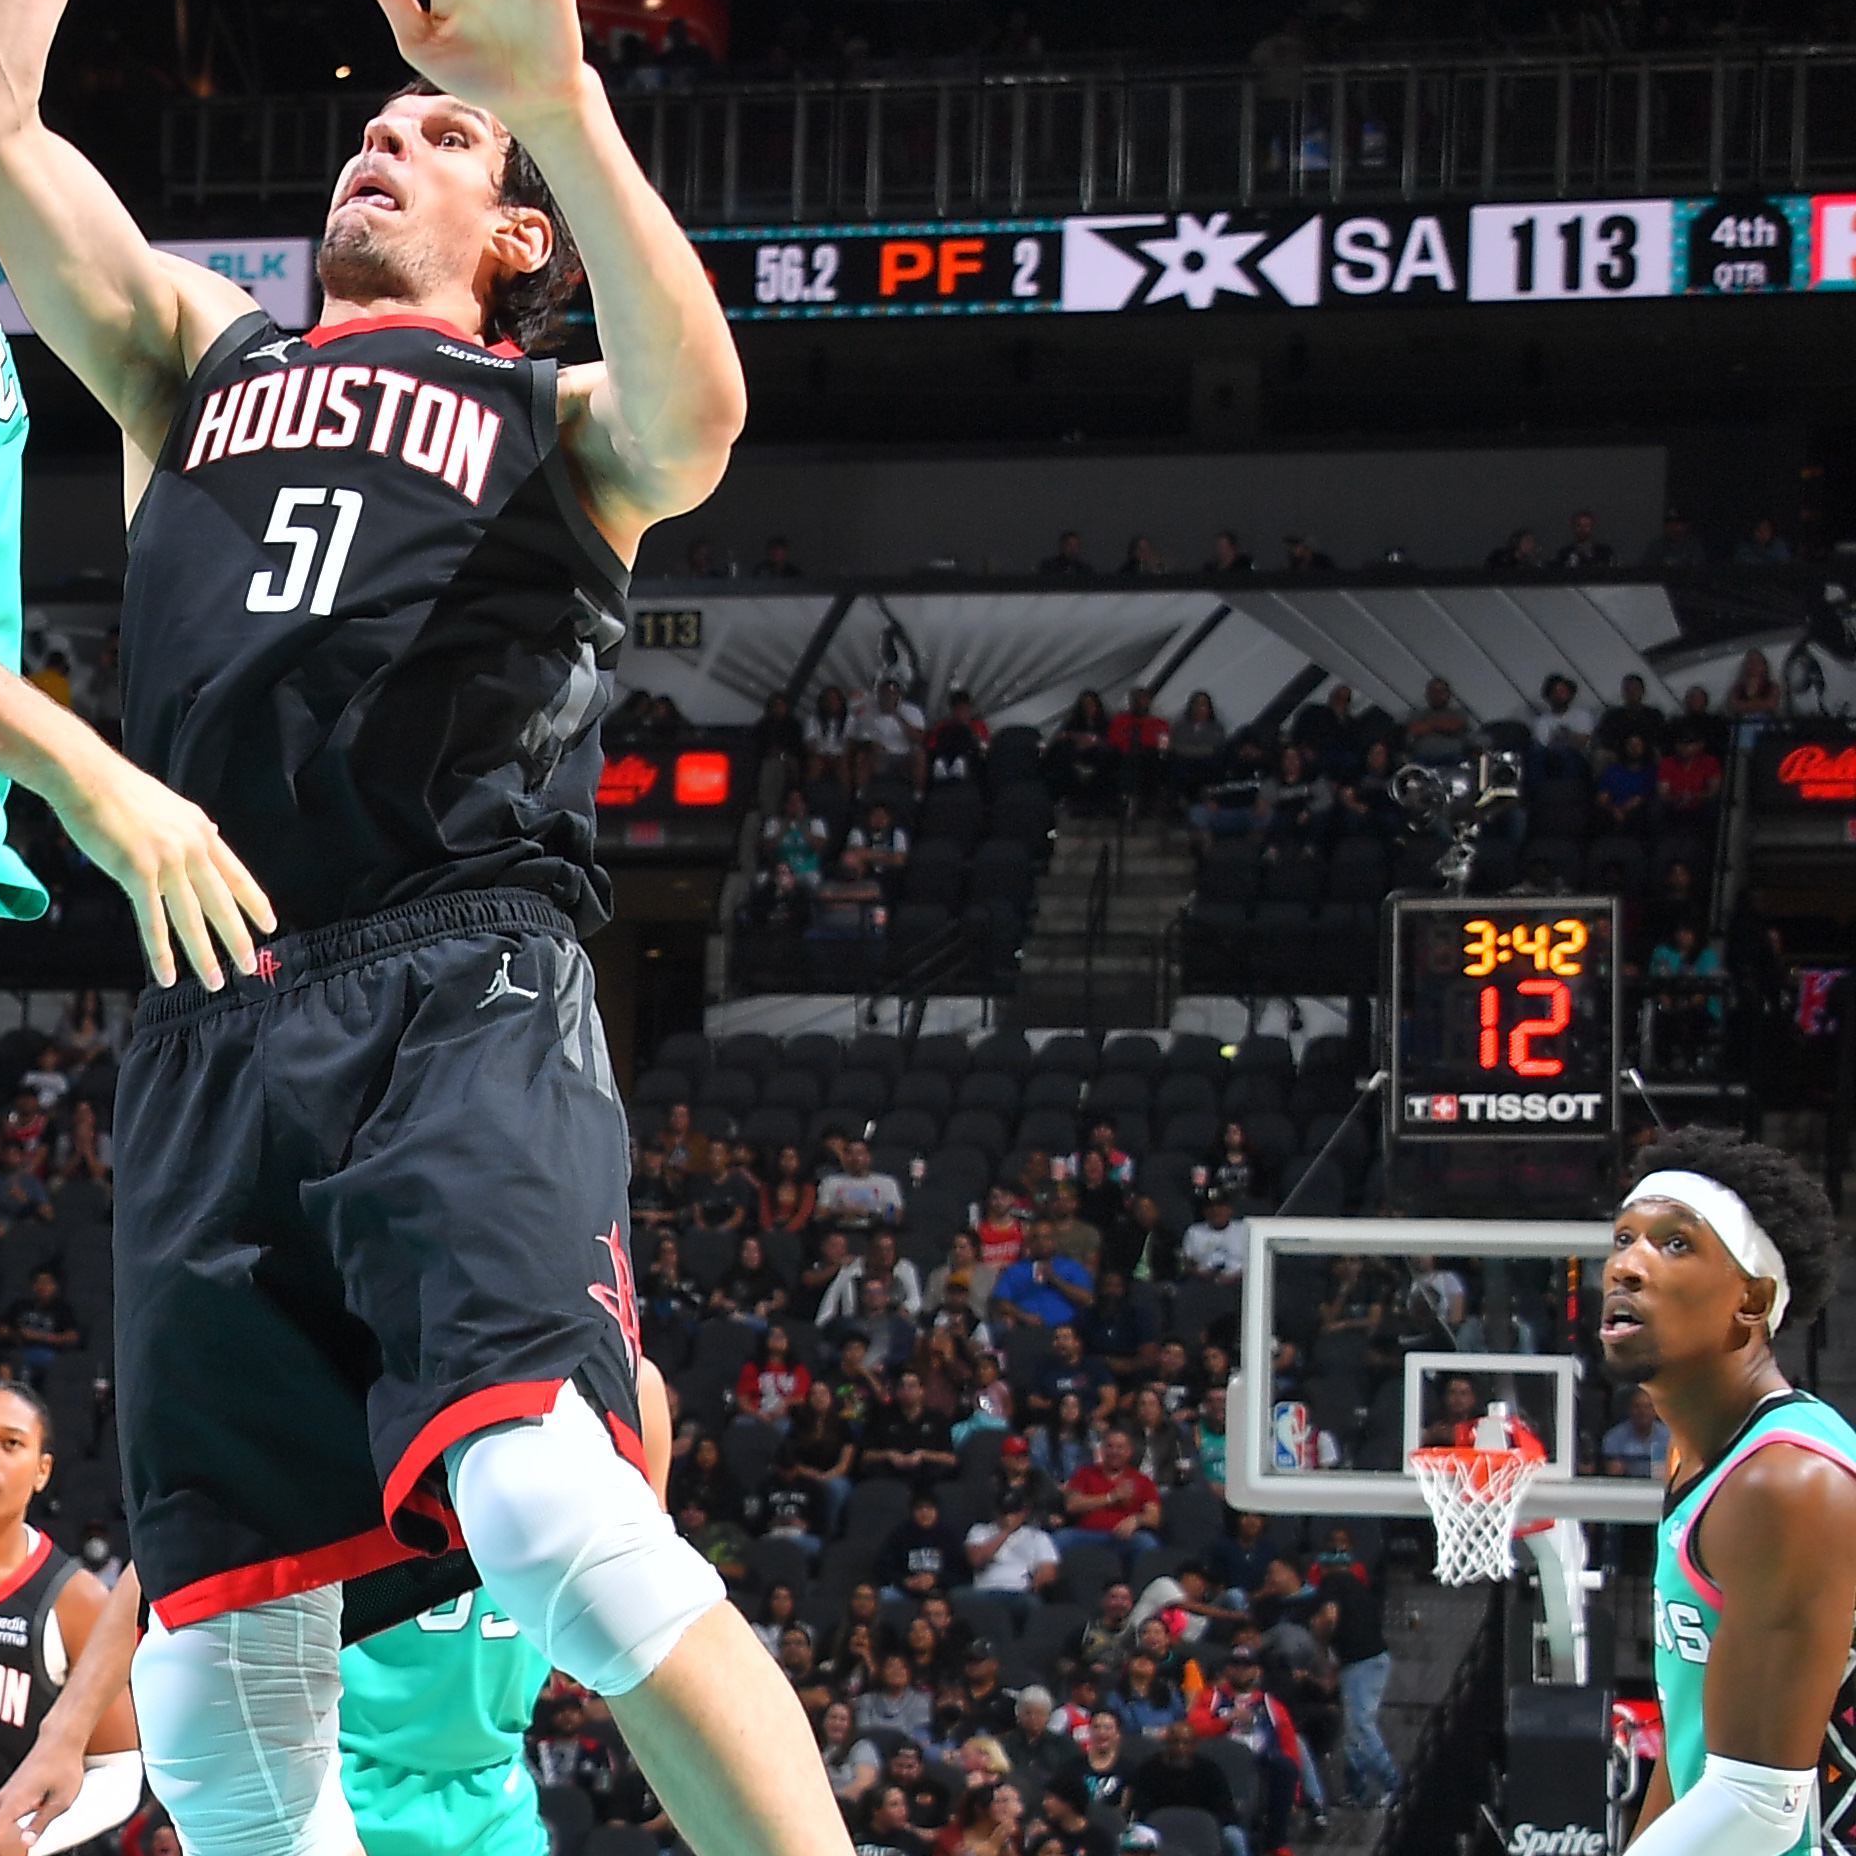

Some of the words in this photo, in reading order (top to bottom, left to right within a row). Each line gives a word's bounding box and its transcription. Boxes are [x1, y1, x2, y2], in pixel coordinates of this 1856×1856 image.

[1331, 215, 1457, 294] SA
[1512, 214, 1640, 294] 113
[1711, 214, 1778, 248] 4th
[207, 251, 288, 280] BLK
[755, 244, 839, 304] 56.2
[879, 238, 985, 296] PF
[1011, 238, 1040, 298] 2
[182, 366, 504, 507] HOUSTON
[245, 487, 364, 616] 51
[1463, 919, 1588, 977] 3:42
[1478, 978, 1572, 1077] 12
[1458, 1093, 1602, 1122] TISSOT
